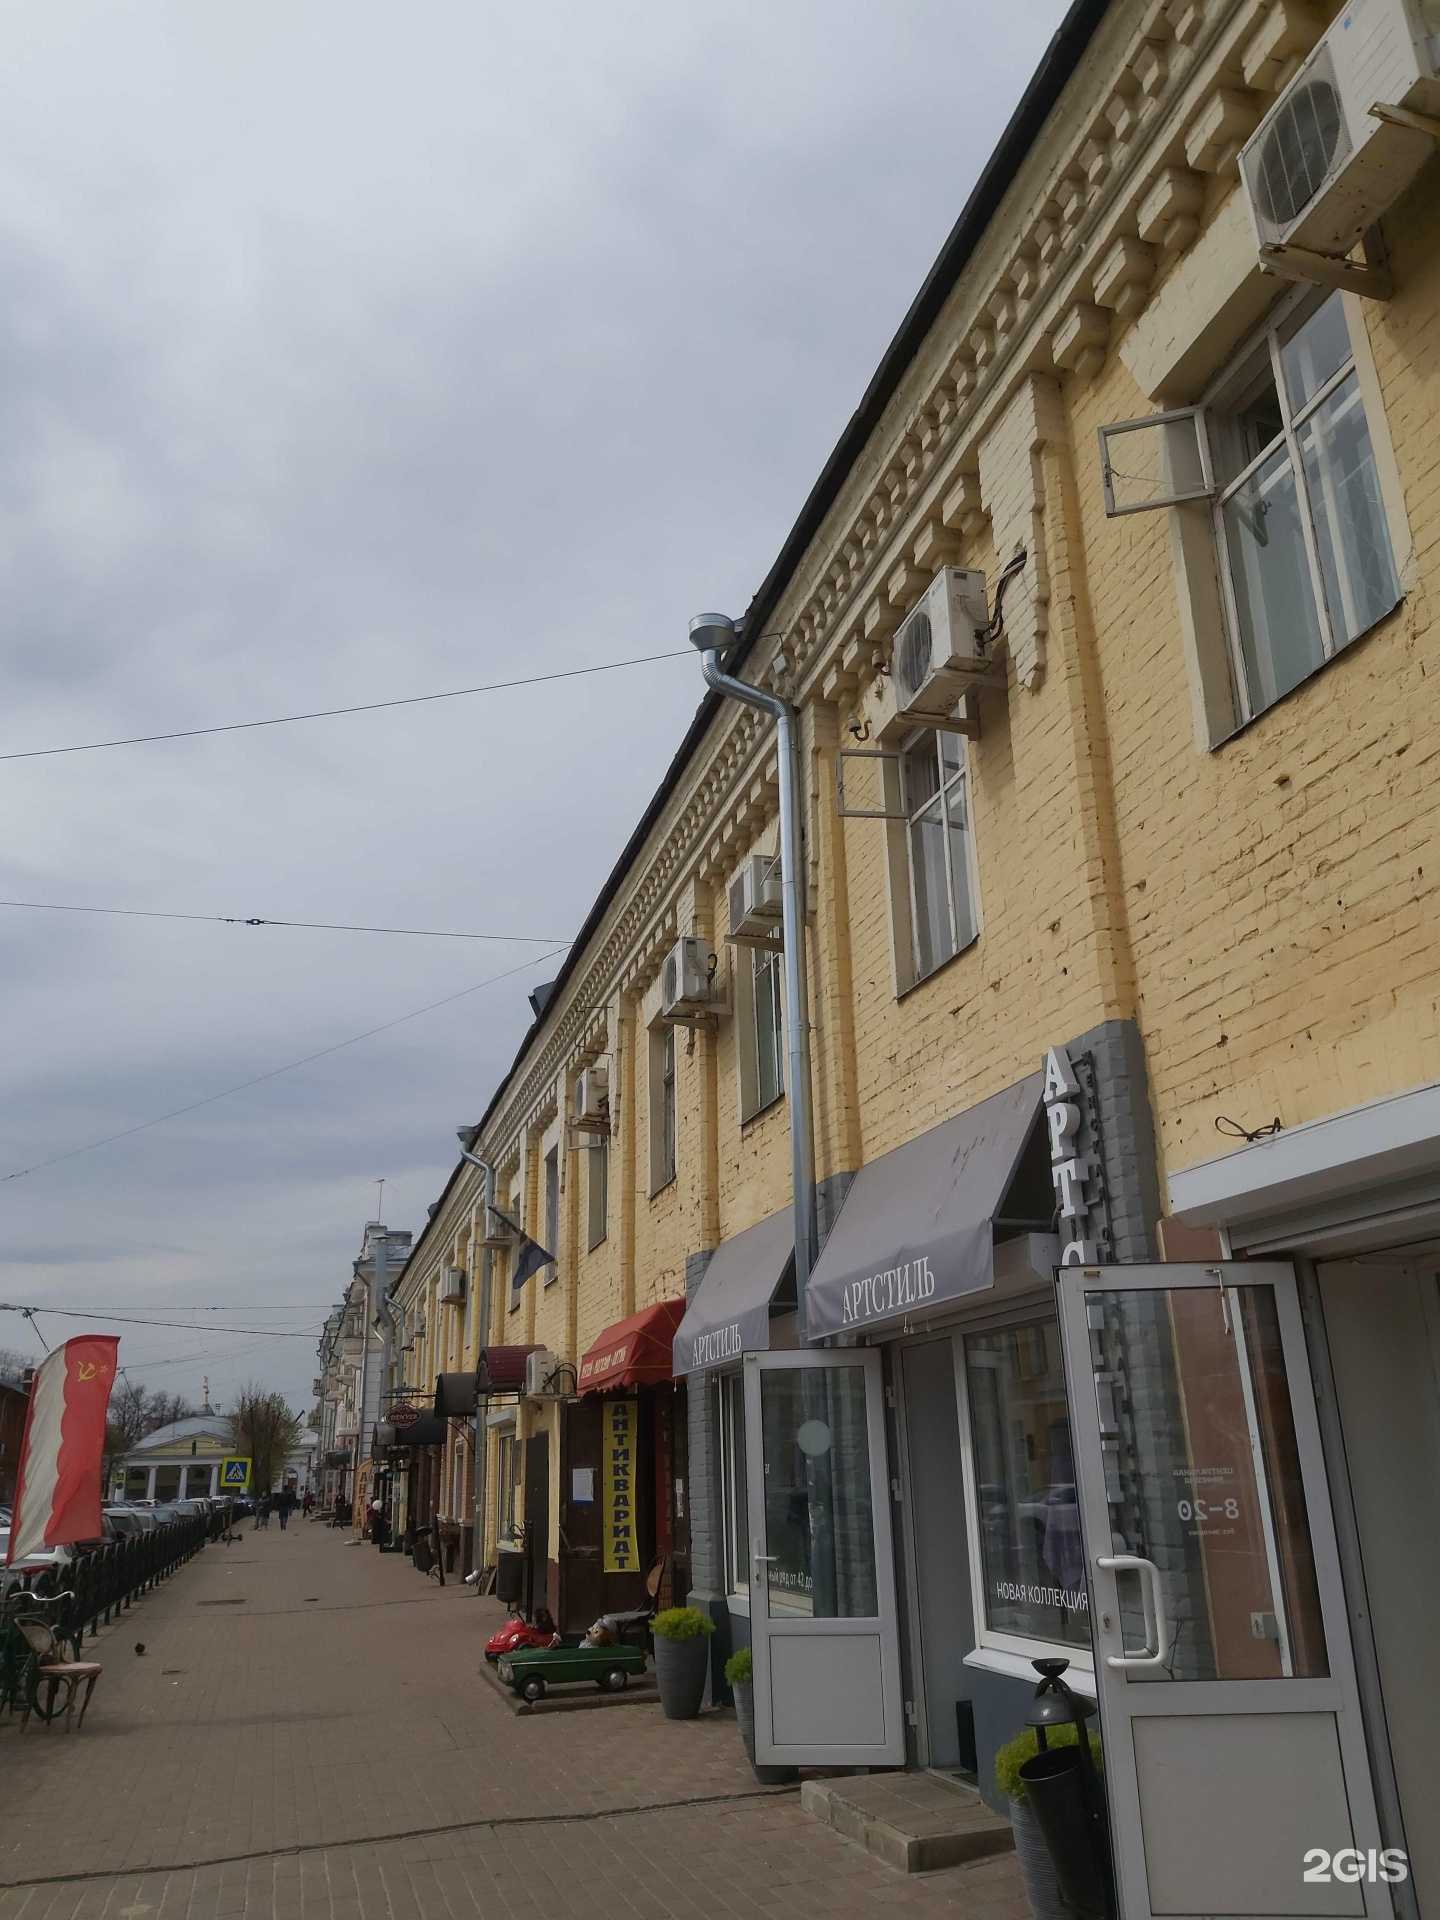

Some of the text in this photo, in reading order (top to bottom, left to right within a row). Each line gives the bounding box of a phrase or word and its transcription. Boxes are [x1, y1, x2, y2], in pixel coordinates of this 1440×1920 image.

[842, 1256, 935, 1324] АРТСТИЛЬ
[692, 1323, 742, 1367] АРТСТИЛЬ
[612, 1403, 631, 1570] АНТИКВАРИАТ
[996, 1581, 1089, 1613] НОВАЯ КОЛЛЕКЦИЯ
